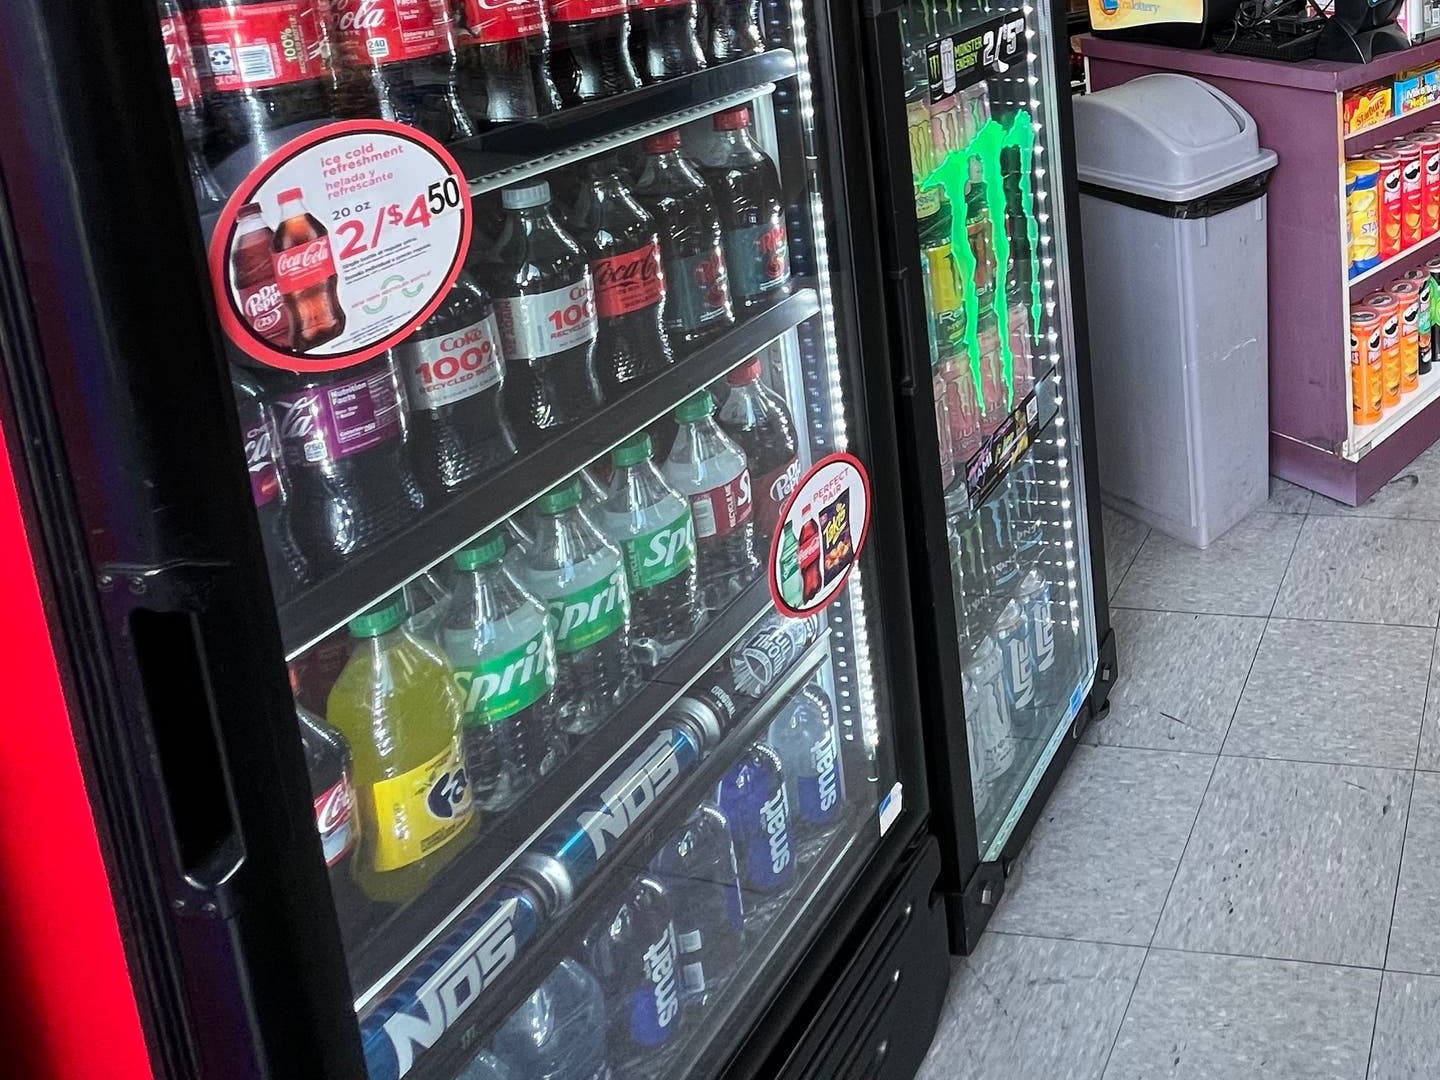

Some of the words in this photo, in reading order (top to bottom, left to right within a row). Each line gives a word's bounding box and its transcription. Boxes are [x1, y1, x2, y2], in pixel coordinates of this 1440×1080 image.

[281, 27, 298, 62] 100%
[955, 36, 983, 58] MONSTER
[956, 52, 979, 72] ENERGY
[320, 154, 341, 168] ice
[345, 142, 375, 161] cold
[322, 145, 404, 178] refreshment
[325, 173, 365, 192] helada
[368, 169, 376, 181] y
[327, 172, 394, 200] refrescante
[332, 208, 351, 221] 20
[355, 201, 371, 213] oz
[1362, 222, 1377, 234] STA
[277, 239, 329, 277] Coca-Cola
[246, 291, 281, 316] Pepp
[261, 283, 278, 301] Dr
[569, 284, 593, 301] Cok
[549, 304, 592, 330] 100
[439, 327, 482, 353] Coke
[419, 372, 474, 393] RECYCLED
[332, 394, 356, 406] Facts
[813, 467, 850, 503] PERFECT
[822, 485, 843, 505] PAIR
[548, 574, 627, 641] Spri
[454, 640, 553, 713] Sprit
[810, 726, 844, 812] smart
[576, 729, 681, 860] NOS
[759, 782, 791, 874] smart
[643, 919, 679, 1029] smart
[384, 896, 519, 1080] NOS
